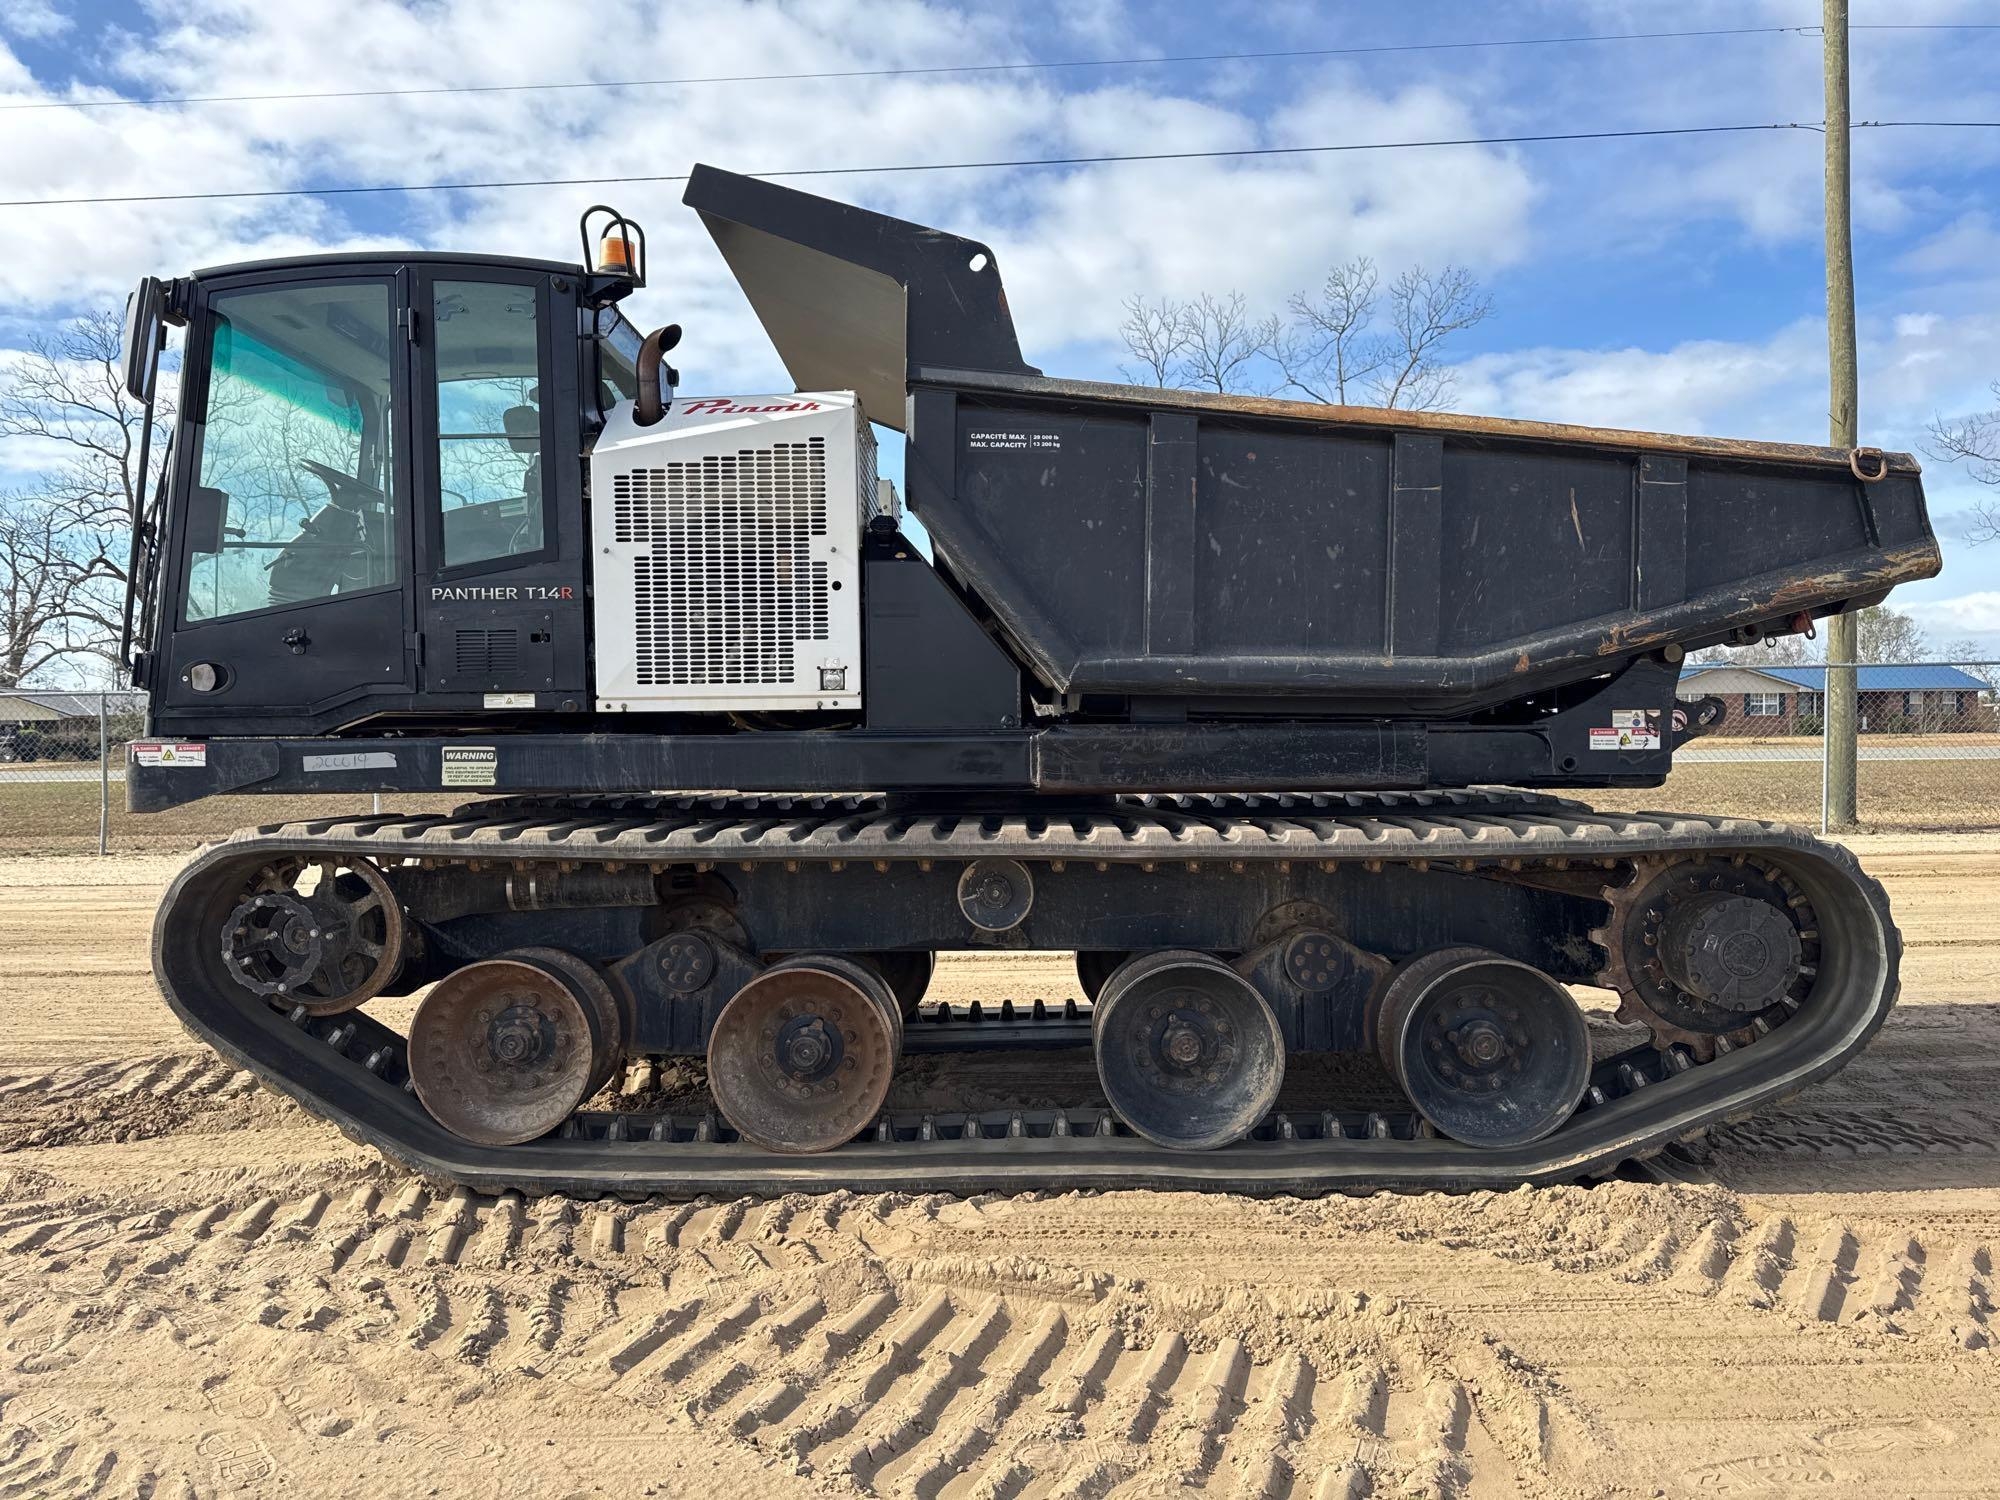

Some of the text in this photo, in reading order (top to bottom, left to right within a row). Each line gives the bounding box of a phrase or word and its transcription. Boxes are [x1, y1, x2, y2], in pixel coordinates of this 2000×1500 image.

[681, 398, 822, 415] Prinoth
[431, 586, 573, 601] PANTHER T14R
[446, 752, 494, 760] WARNING
